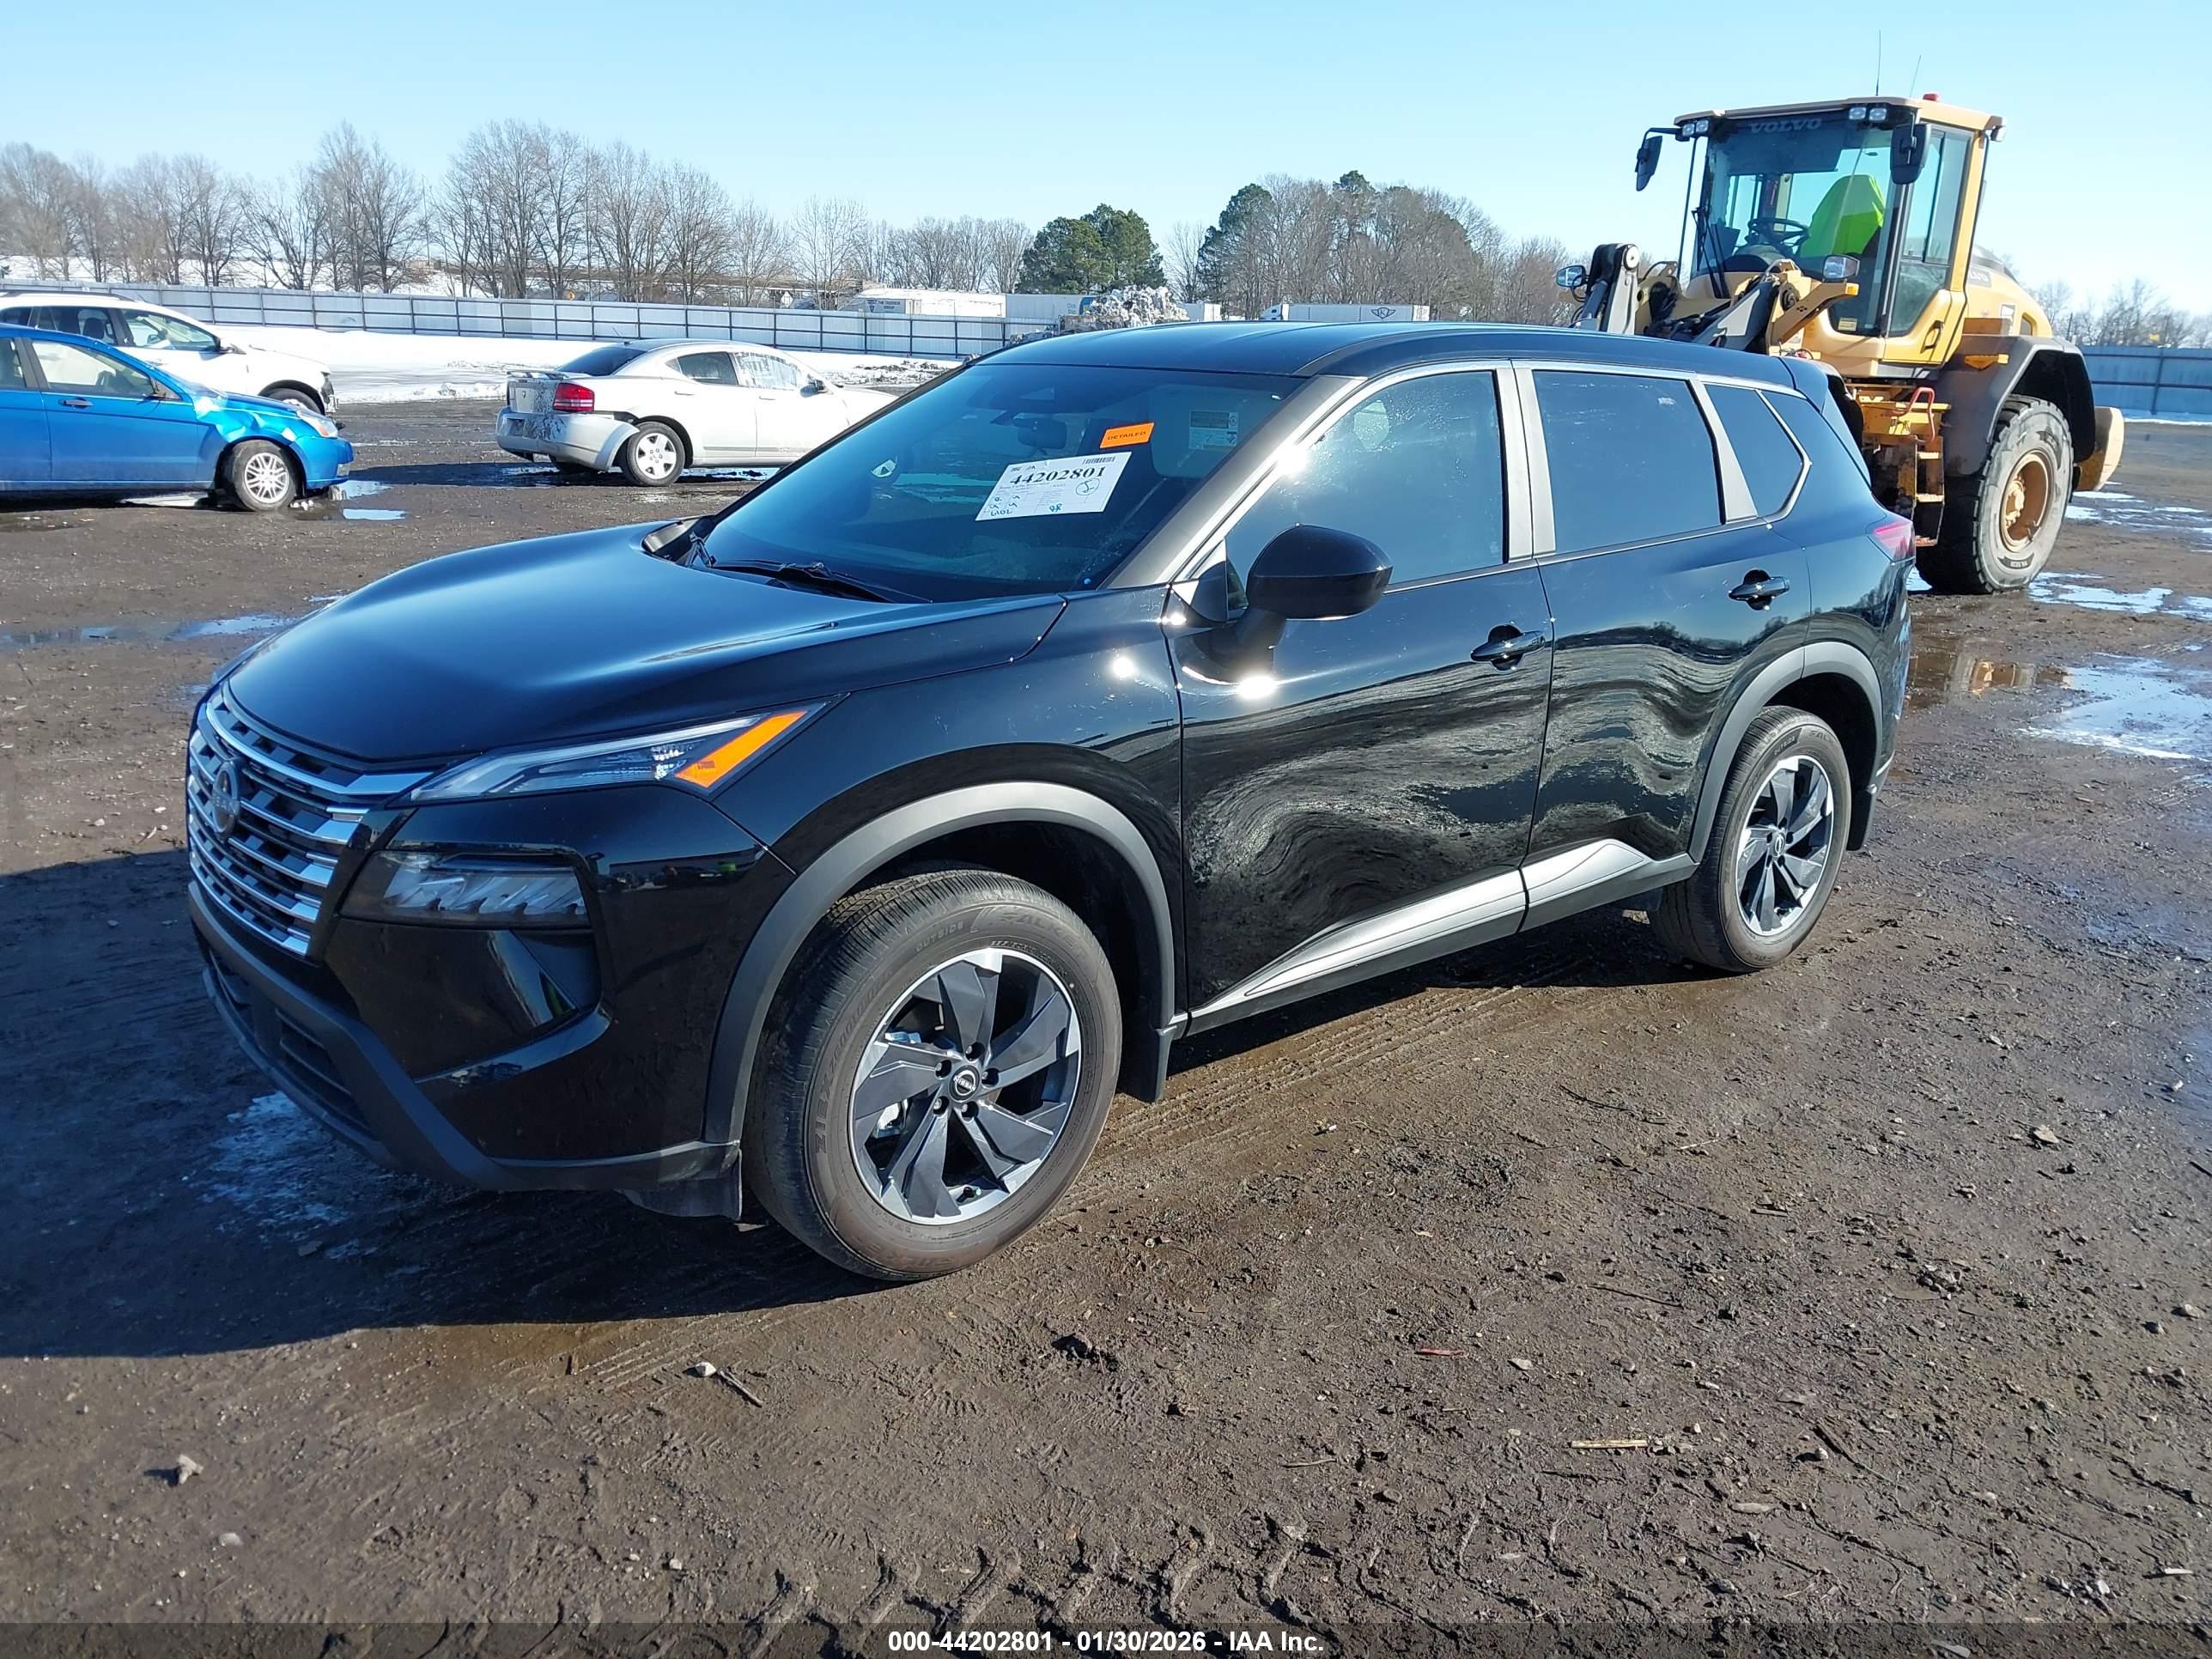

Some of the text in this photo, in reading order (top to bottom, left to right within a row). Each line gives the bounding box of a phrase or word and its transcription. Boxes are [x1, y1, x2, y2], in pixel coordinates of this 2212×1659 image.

[1750, 118, 1821, 134] VOLVO
[1107, 430, 1146, 441] DETAILED
[1010, 466, 1106, 485] 44202801
[915, 920, 963, 952] OUTSIDE
[815, 1077, 834, 1154] ZIEX
